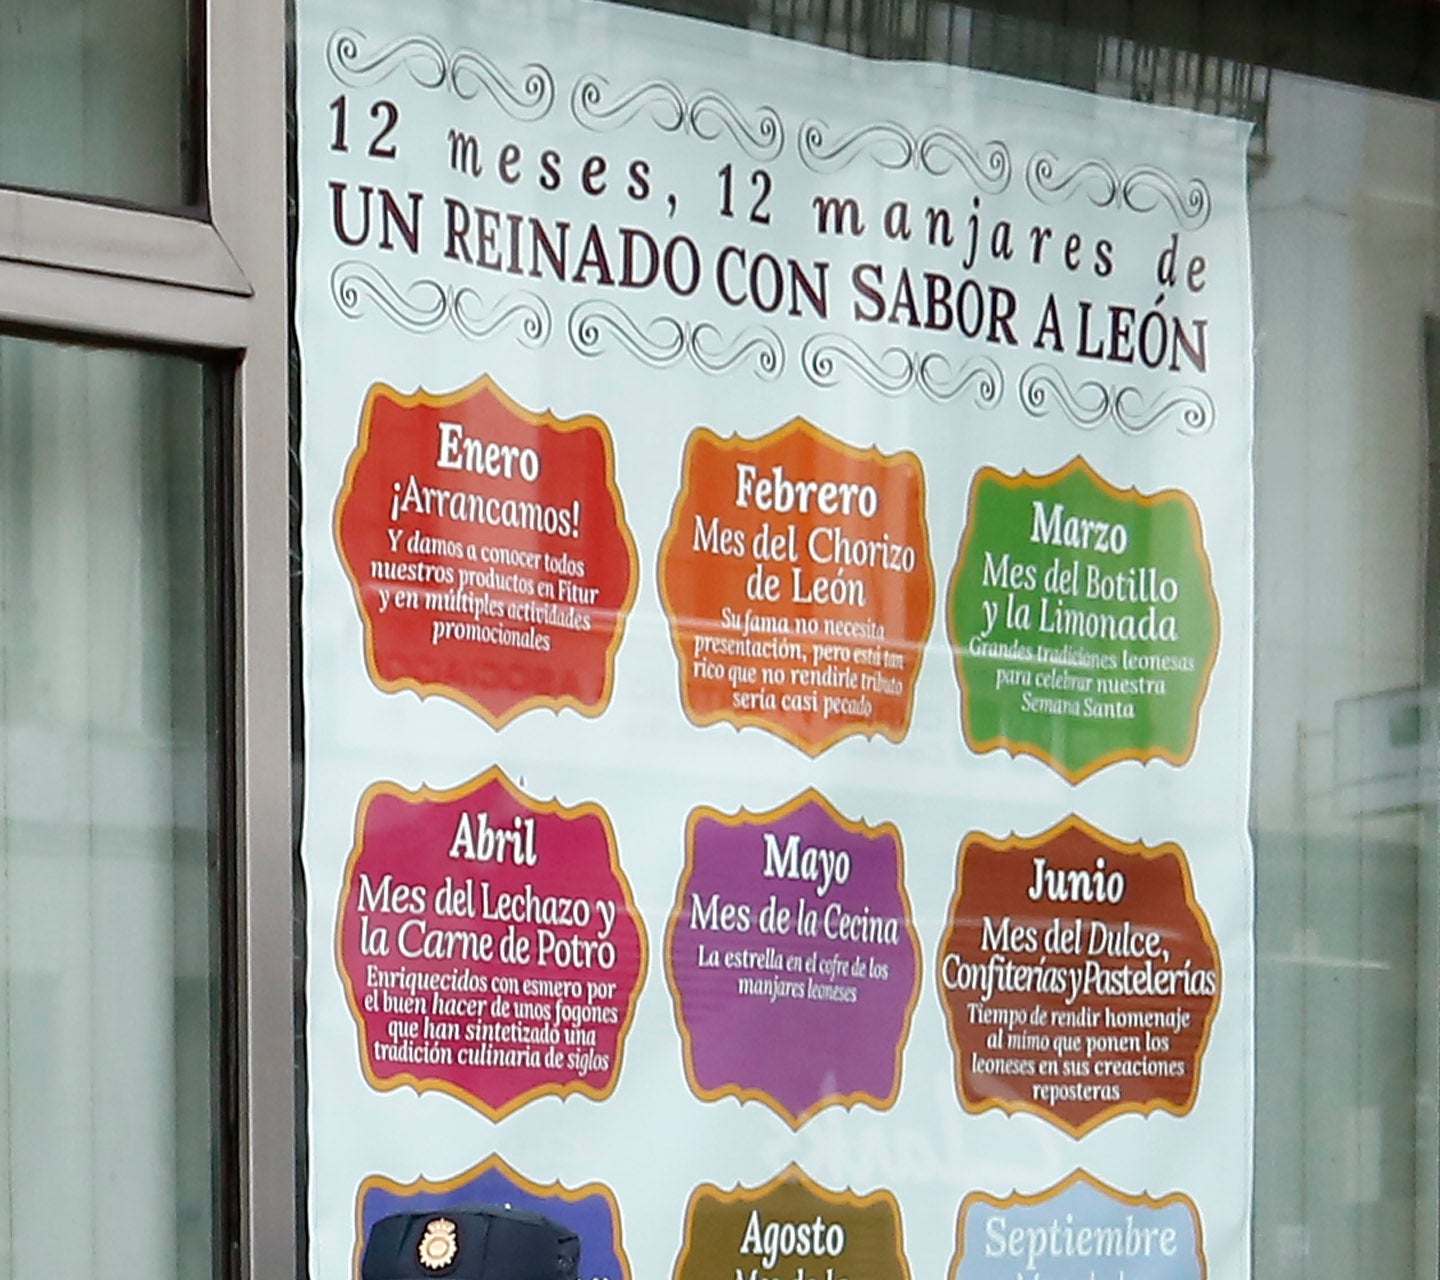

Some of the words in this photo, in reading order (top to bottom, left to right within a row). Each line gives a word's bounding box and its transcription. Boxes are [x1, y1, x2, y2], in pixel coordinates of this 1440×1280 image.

[330, 95, 398, 158] 12
[448, 123, 676, 217] meses,
[719, 164, 771, 224] 12
[813, 196, 1112, 288] manjares
[1158, 233, 1205, 292] de
[329, 182, 423, 254] UN
[444, 194, 700, 296] REINADO
[717, 246, 829, 318] CON
[853, 264, 1018, 345] SABOR
[1033, 303, 1066, 350] A
[1077, 293, 1206, 372] LEÓN
[438, 423, 538, 481] Enero
[392, 476, 578, 538] ¡Arrancamos!
[736, 464, 877, 517] Febrero
[388, 529, 403, 552] Y
[408, 530, 464, 558] damos
[467, 545, 477, 560] a
[481, 547, 541, 569] conocer
[545, 553, 584, 577] todos
[693, 515, 745, 556] Mes
[753, 523, 798, 562] del
[809, 527, 914, 576] Chorizo
[1031, 502, 1127, 554] Marzo
[372, 562, 454, 583] nuestros
[458, 567, 534, 595] productos
[538, 582, 554, 598] en
[559, 580, 599, 604] Fitur
[747, 564, 780, 601] de
[793, 567, 866, 606] León
[983, 552, 1036, 590] Mes
[1044, 558, 1079, 596] del
[1087, 565, 1178, 603] Botillo
[433, 622, 550, 651] promocionales
[981, 601, 998, 638] y
[1007, 593, 1030, 630] la
[1040, 598, 1180, 641] Limonada
[450, 813, 536, 865] Abril
[764, 834, 849, 896] Mayo
[1029, 858, 1124, 902] Junio
[358, 874, 426, 914] Mes
[435, 877, 475, 918] del
[482, 883, 590, 926] Lechazo
[596, 900, 615, 939] y
[691, 894, 750, 931] Mes
[760, 896, 790, 934] de
[798, 898, 817, 936] la
[824, 904, 898, 944] Cecina
[362, 916, 389, 956] la
[398, 920, 493, 960] Carne
[500, 925, 530, 964] de
[538, 930, 614, 968] Potro
[982, 917, 1037, 952] Mes
[1045, 918, 1081, 954] del
[1088, 922, 1168, 962] Dulce,
[368, 965, 487, 996] Enriquecidos
[492, 977, 519, 994] con
[523, 980, 582, 997] esmero
[588, 982, 616, 1004] por
[942, 954, 1072, 1003] Confiterías
[1066, 968, 1082, 1004] y
[1083, 960, 1216, 995] Pastelerías
[365, 989, 378, 1011] el
[384, 990, 426, 1014] buen
[432, 992, 487, 1016] hacer
[491, 995, 510, 1018] de
[514, 1002, 551, 1020] unos
[555, 999, 618, 1028] fogones
[389, 1021, 418, 1045] que
[424, 1016, 459, 1040] han
[465, 1018, 560, 1044] sintetizado
[564, 1029, 595, 1045] una
[375, 1040, 452, 1064] tradición
[458, 1043, 540, 1067] culinaria
[545, 1046, 563, 1068] de
[567, 1048, 609, 1076] siglos
[740, 1210, 844, 1269] Agosto
[986, 1213, 1176, 1270] Septiembre
